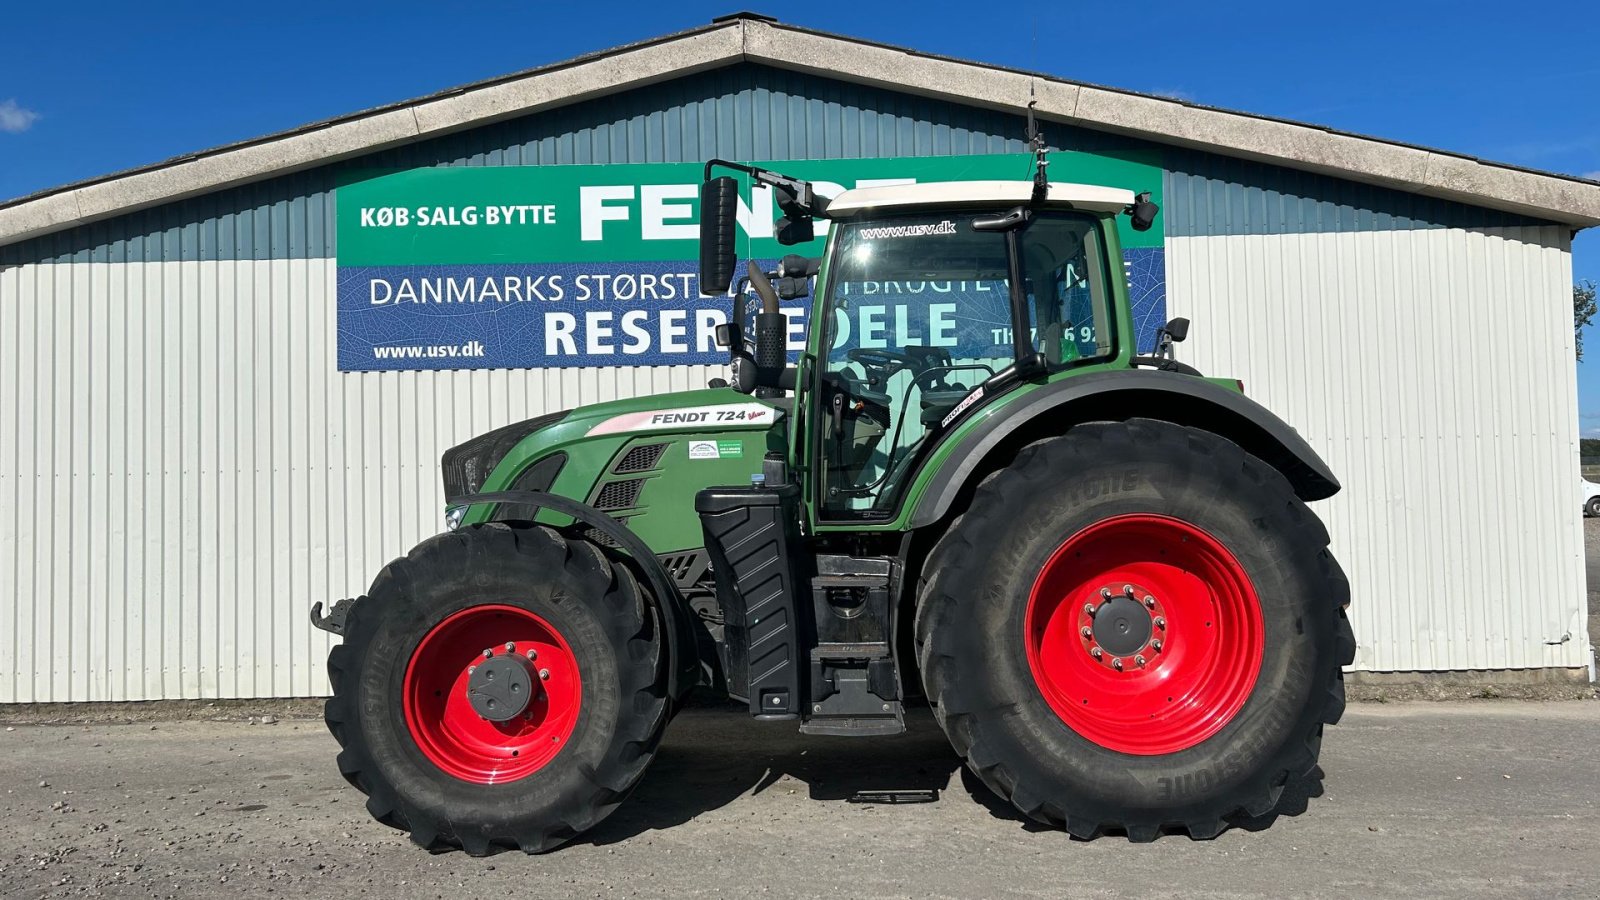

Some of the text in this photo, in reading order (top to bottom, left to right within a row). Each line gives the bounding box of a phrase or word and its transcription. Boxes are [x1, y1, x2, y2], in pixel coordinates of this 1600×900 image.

[578, 179, 917, 242] FEN
[860, 220, 957, 239] www.usv.dk
[369, 275, 563, 305] DANMARKS
[544, 303, 958, 356] RESEREELE
[374, 341, 485, 360] www.usv.dk
[652, 412, 709, 424] FENDT
[716, 410, 746, 422] 724
